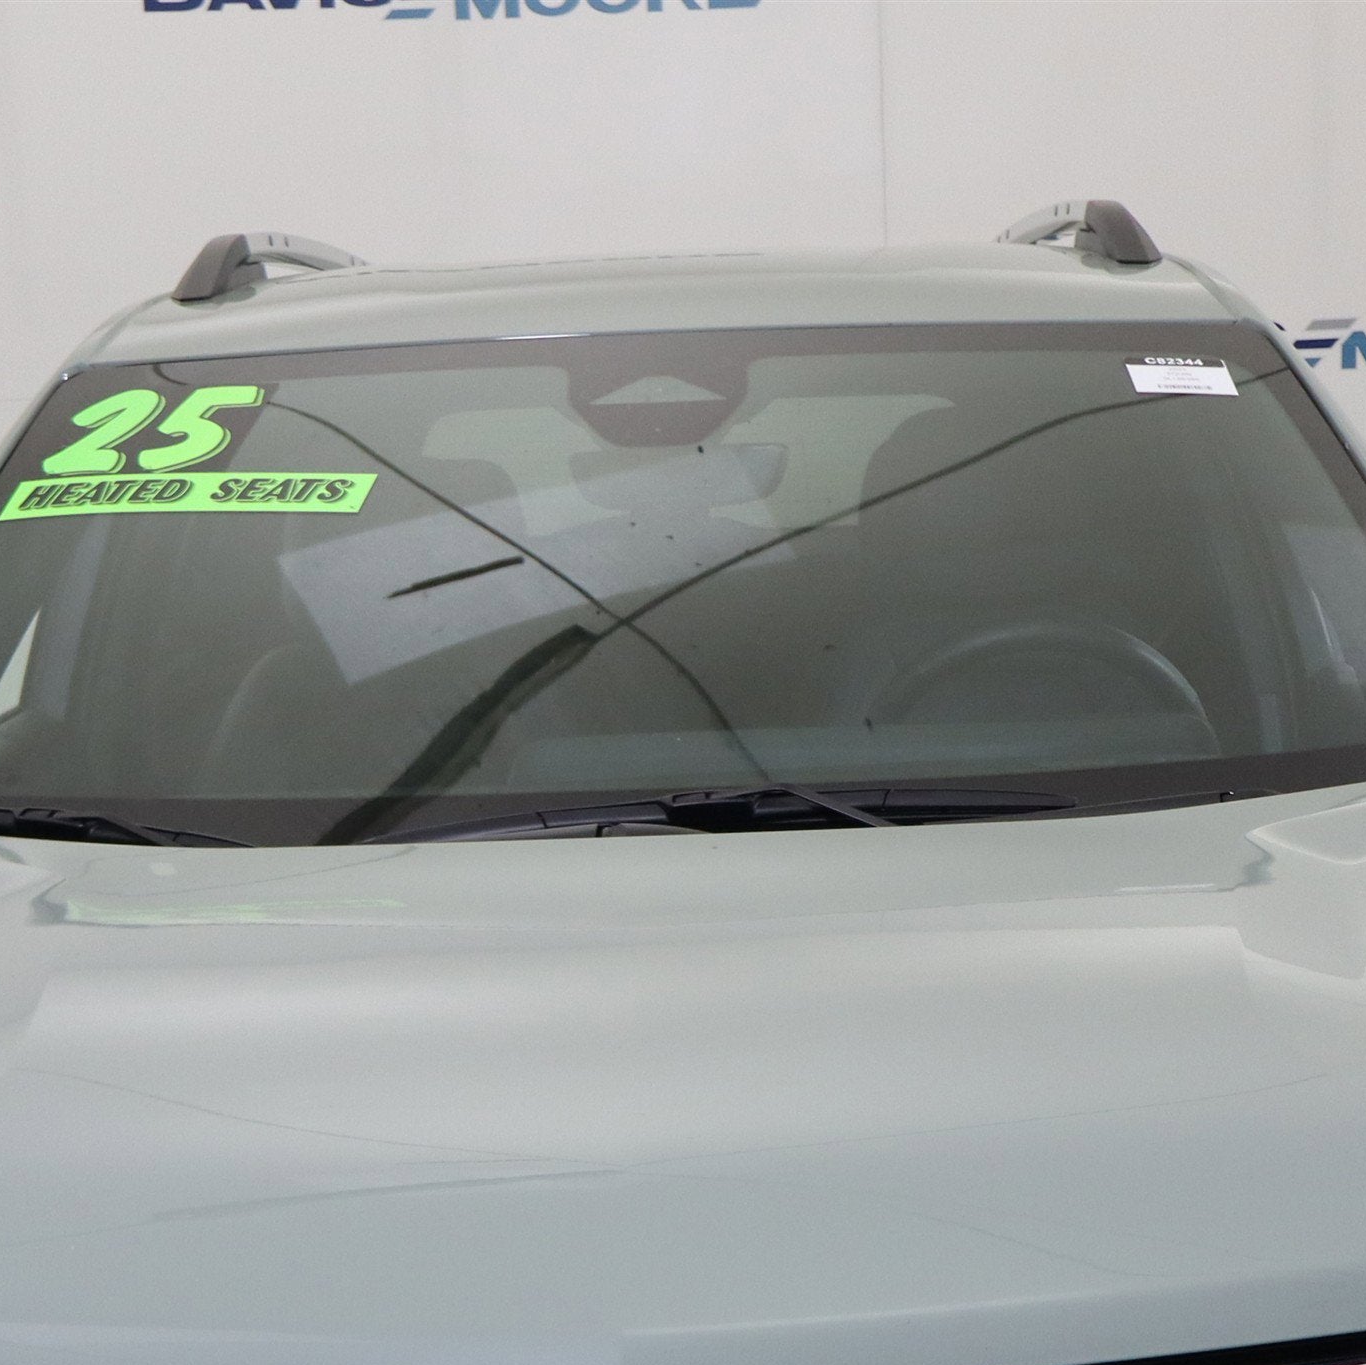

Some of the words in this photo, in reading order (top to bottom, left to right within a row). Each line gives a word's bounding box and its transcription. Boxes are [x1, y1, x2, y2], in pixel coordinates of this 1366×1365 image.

[42, 385, 265, 476] 25
[18, 478, 195, 512] HEATED
[210, 477, 355, 504] SEATS
